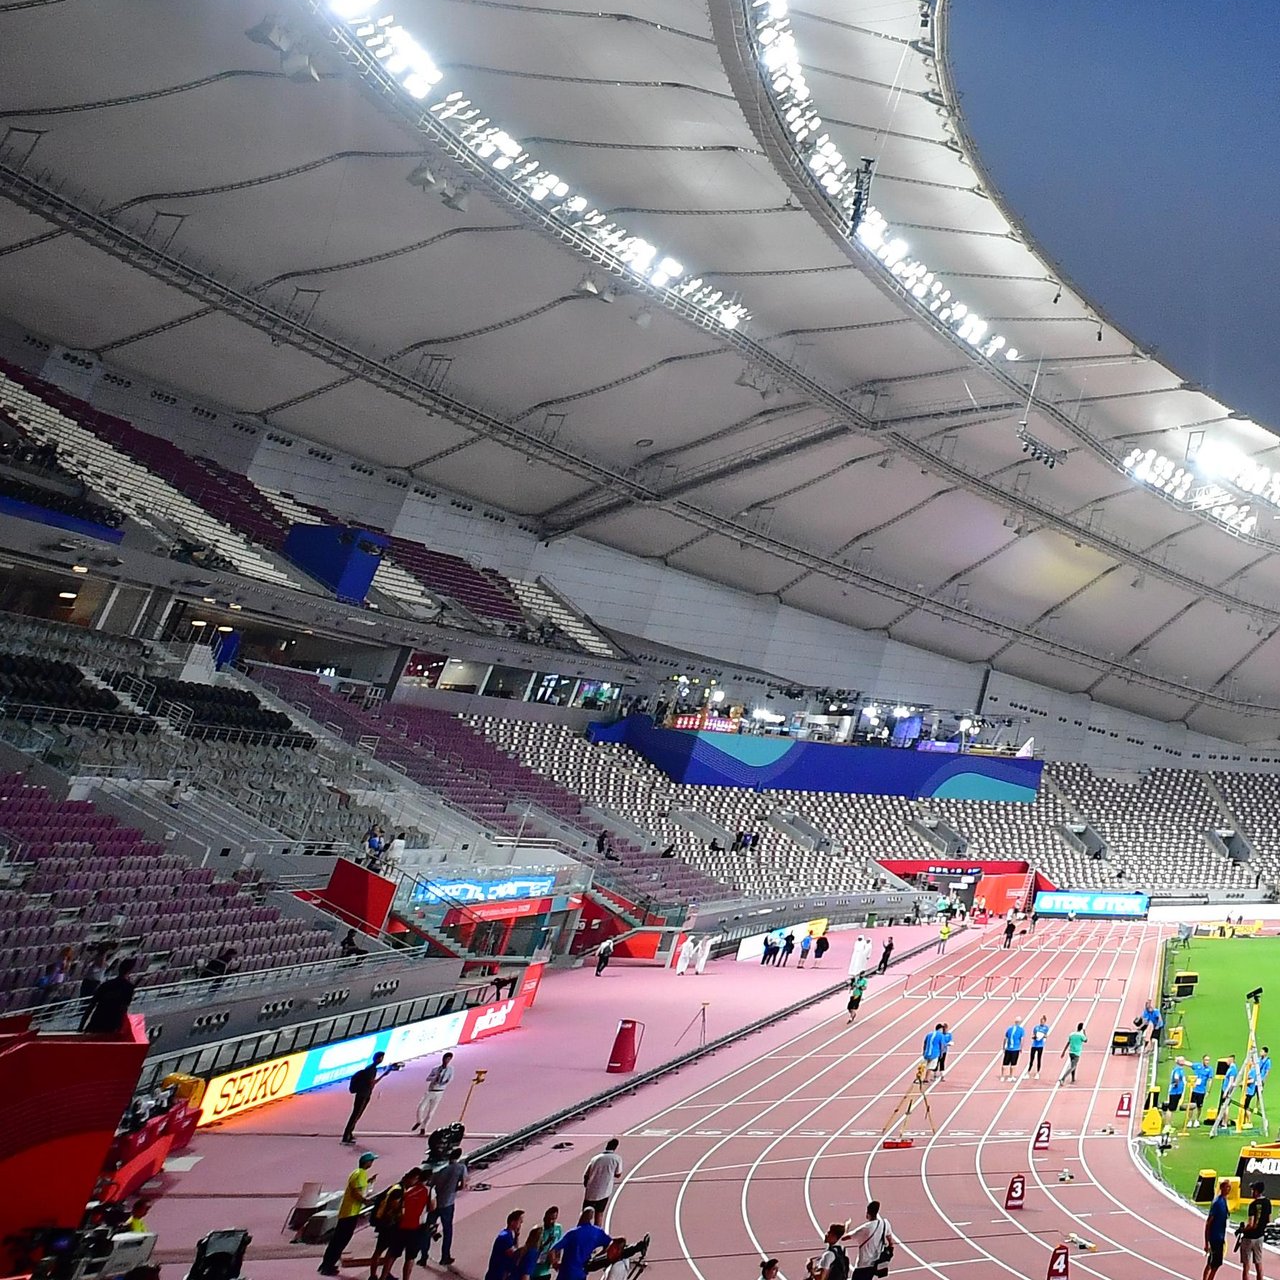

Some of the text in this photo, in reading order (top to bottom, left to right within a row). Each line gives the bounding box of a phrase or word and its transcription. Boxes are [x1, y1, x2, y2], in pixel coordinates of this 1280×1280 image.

[213, 1060, 290, 1115] SEIKO
[1123, 1098, 1129, 1110] 1
[1039, 1127, 1049, 1141] 2
[1011, 1182, 1022, 1197] 3
[1052, 1254, 1066, 1273] 4
